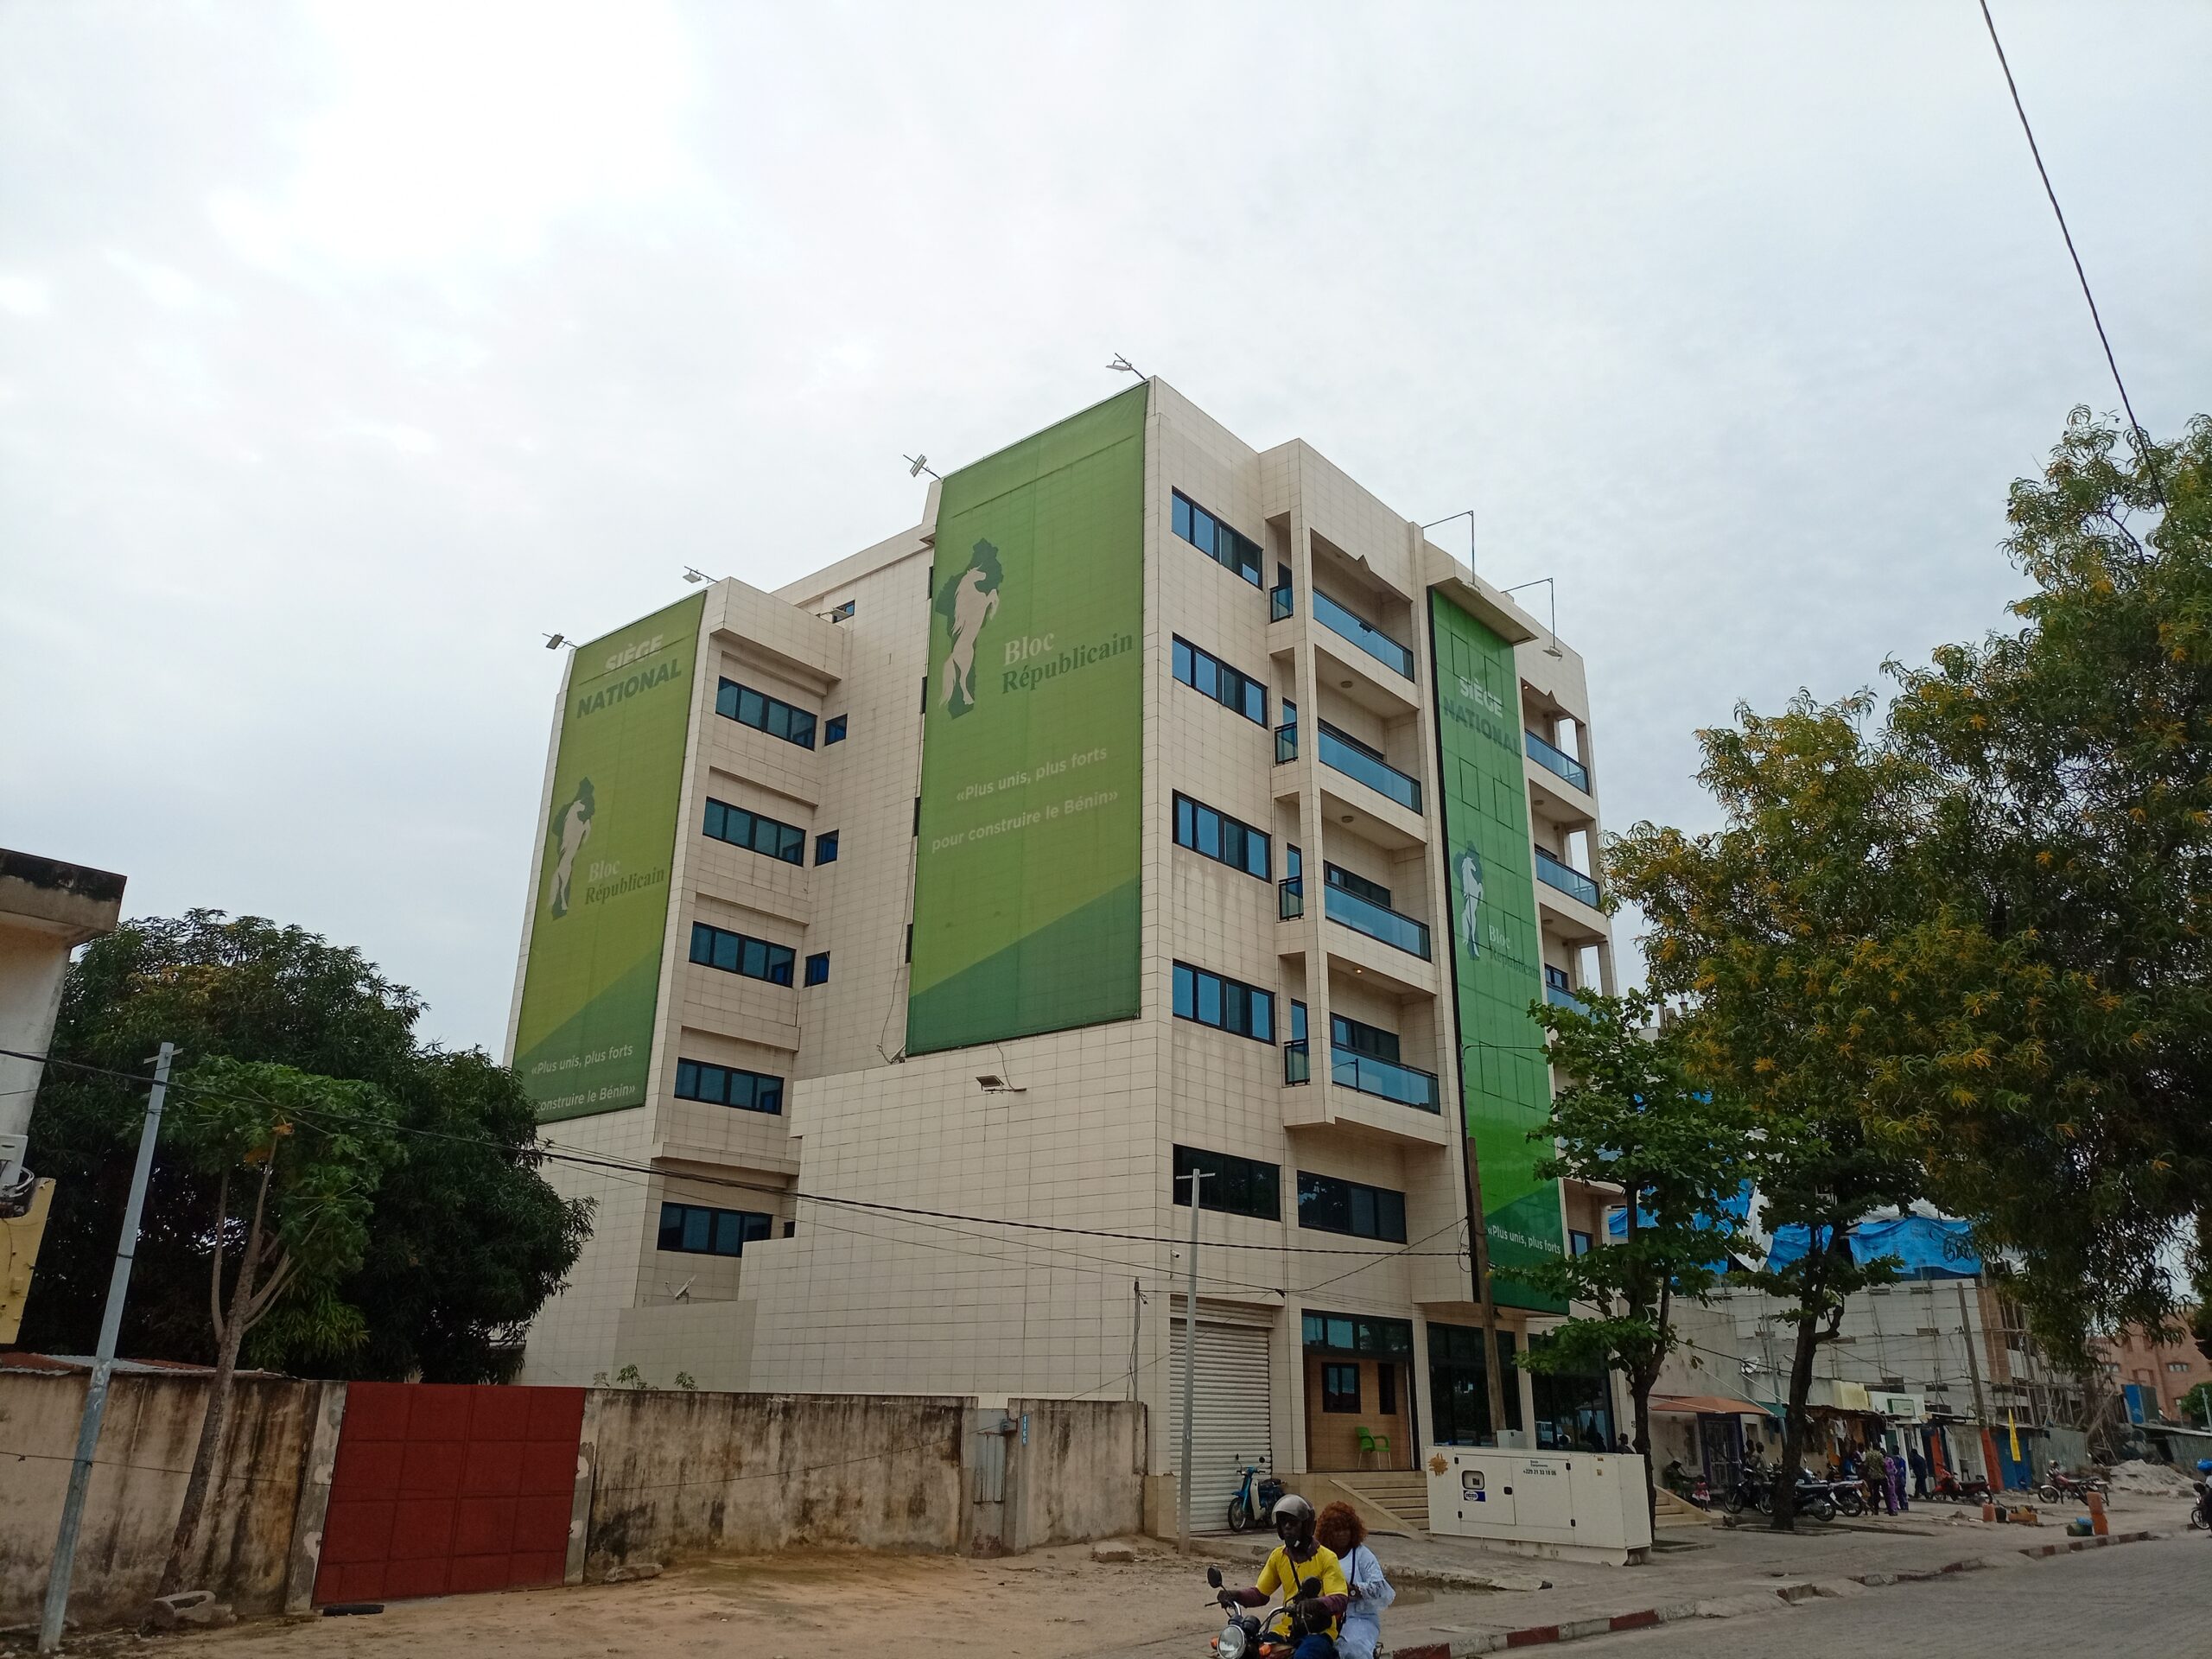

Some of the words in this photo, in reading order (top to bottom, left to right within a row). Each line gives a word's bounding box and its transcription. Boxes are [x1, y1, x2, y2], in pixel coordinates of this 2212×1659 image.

[604, 634, 664, 676] SIÈGE
[1001, 632, 1133, 694] Républicain
[1004, 632, 1055, 665] Bloc
[576, 658, 682, 719] NATIONAL
[1459, 676, 1503, 719] SIÈGE
[1442, 695, 1522, 759] NATIONAL
[998, 771, 1031, 790] unis,
[1036, 760, 1066, 781] plus
[1071, 747, 1107, 768] forts
[931, 832, 964, 854] pour
[969, 811, 1041, 841] construire
[1046, 805, 1058, 820] le
[585, 867, 664, 905] Républicain
[588, 860, 621, 881] Bloc
[1489, 924, 1511, 950] Bloc
[559, 1054, 582, 1069] unis,
[584, 1050, 606, 1067] plus
[608, 1045, 633, 1059] forts
[587, 1090, 597, 1103] le
[1510, 1232, 1526, 1247] unis,
[1528, 1236, 1543, 1250] plus
[1544, 1239, 1561, 1255] forts
